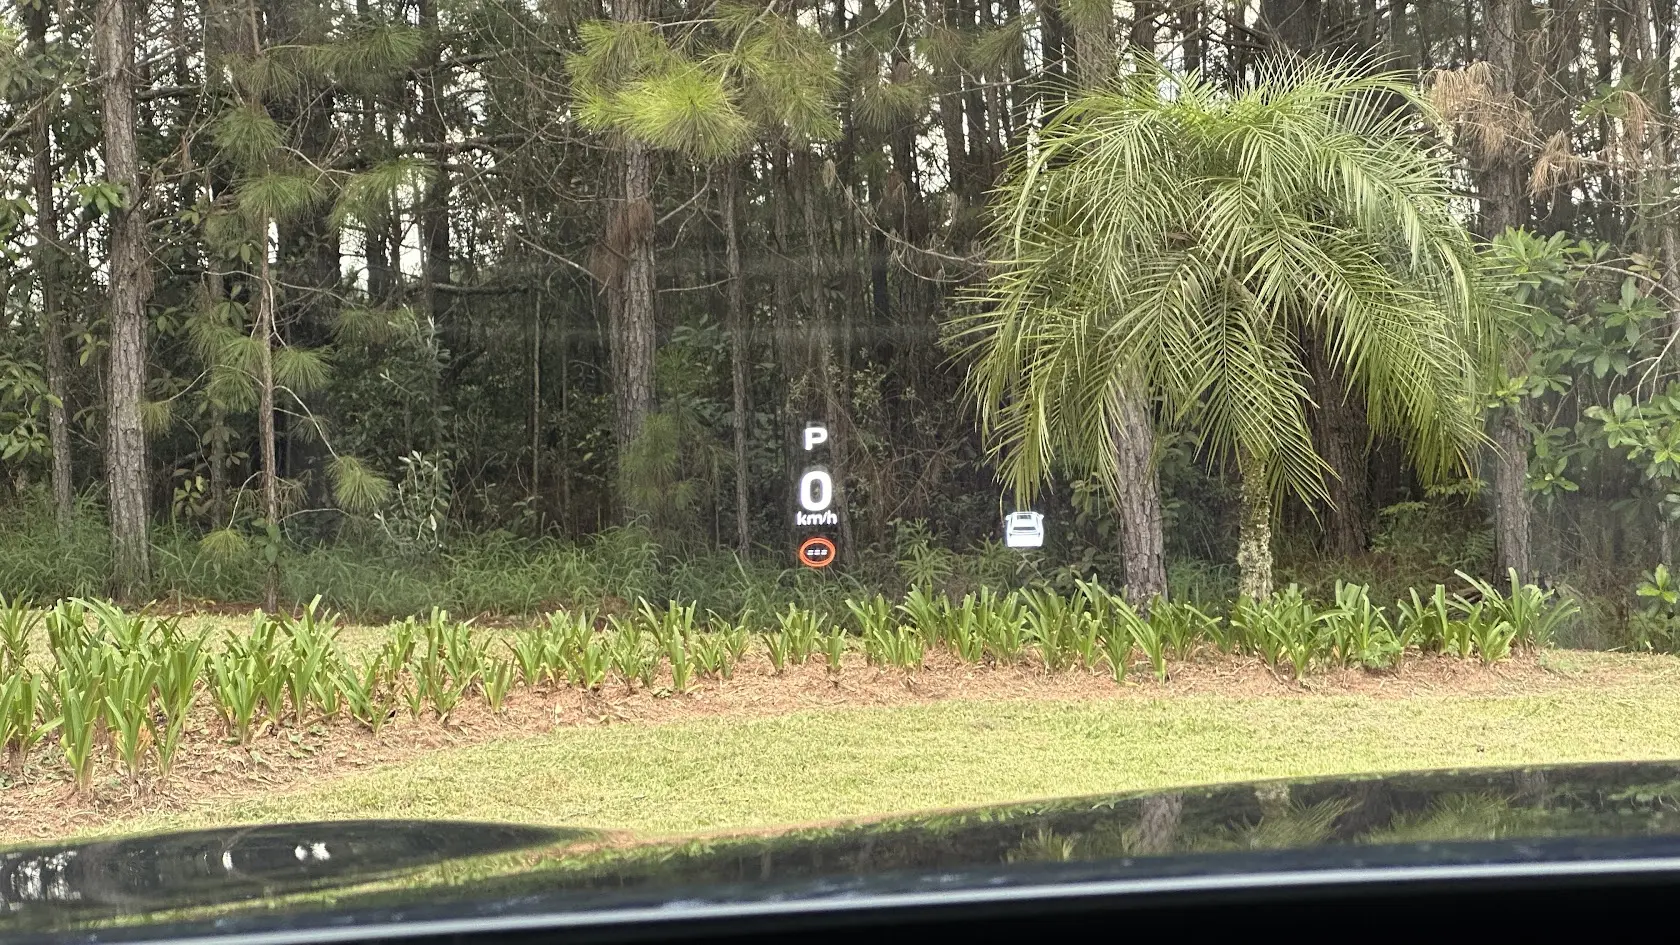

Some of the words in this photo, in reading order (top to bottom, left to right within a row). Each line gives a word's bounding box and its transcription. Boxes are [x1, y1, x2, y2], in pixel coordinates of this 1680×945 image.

[804, 427, 828, 450] P
[800, 471, 832, 511] 0
[796, 510, 838, 525] km/h
